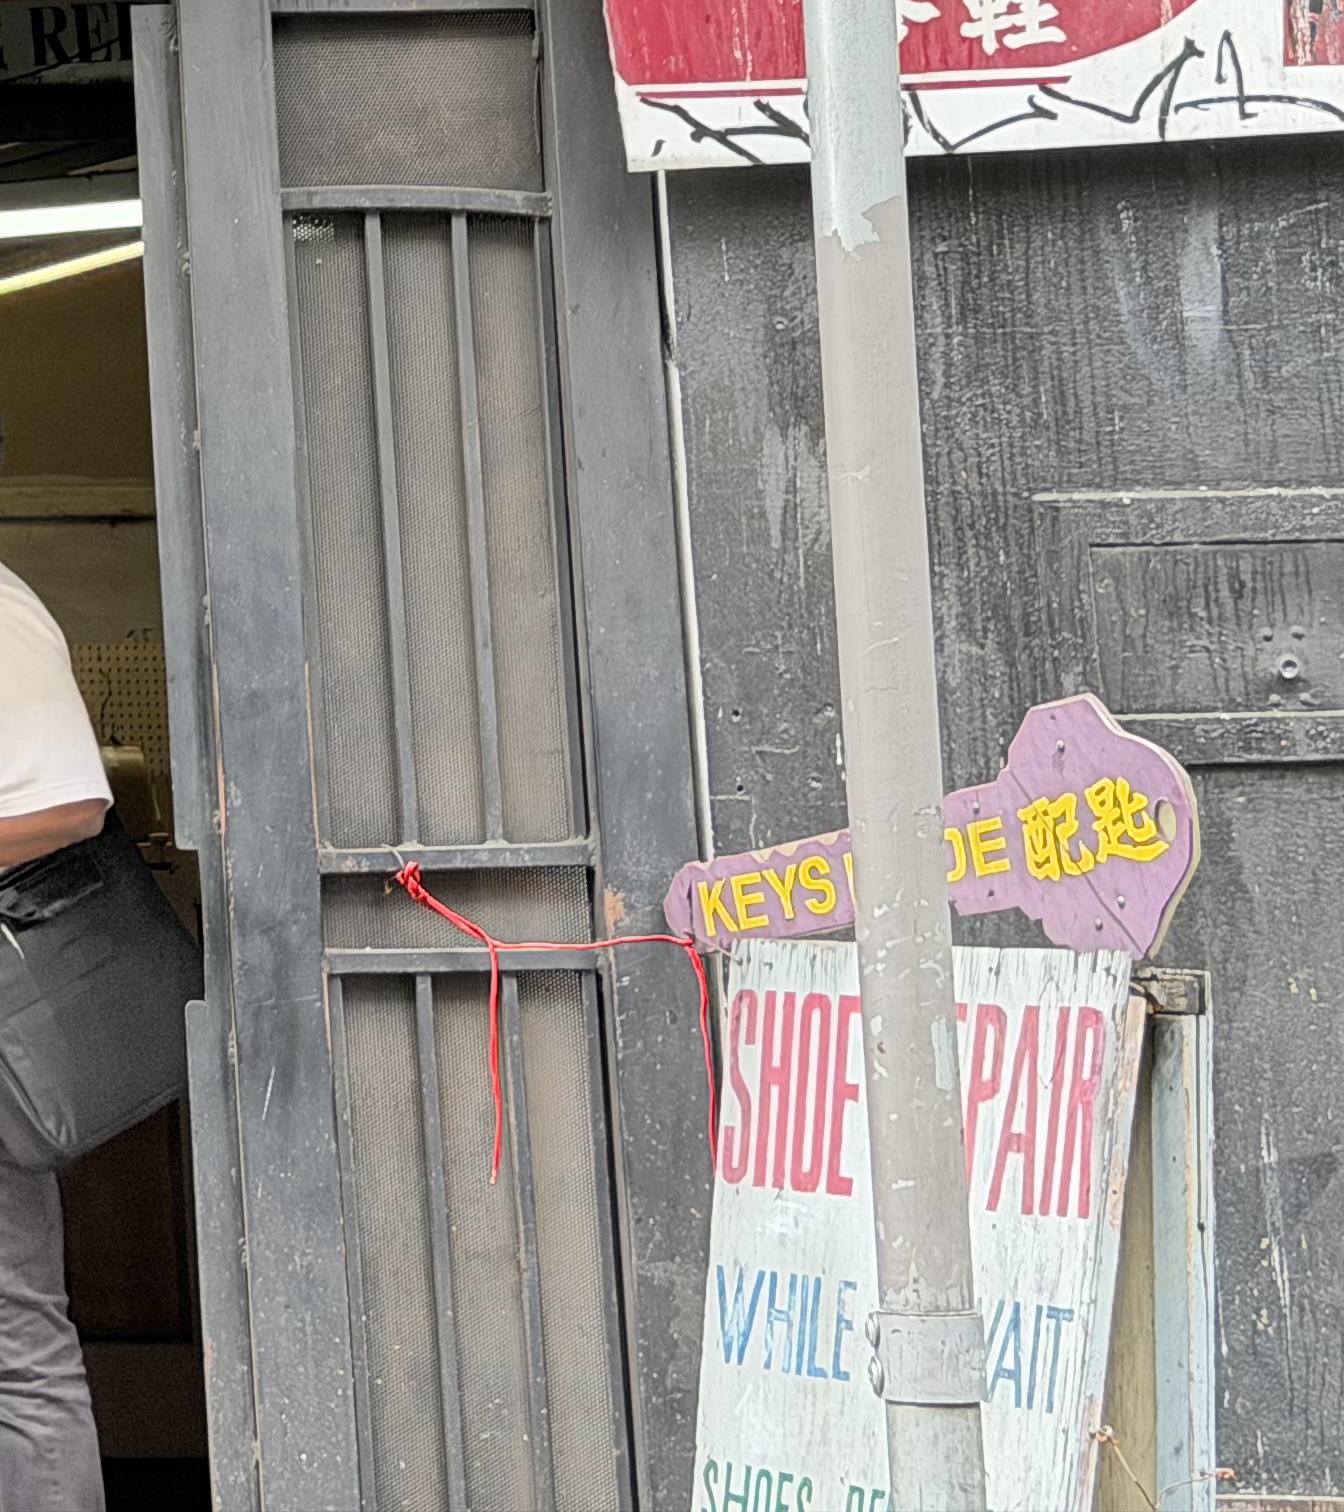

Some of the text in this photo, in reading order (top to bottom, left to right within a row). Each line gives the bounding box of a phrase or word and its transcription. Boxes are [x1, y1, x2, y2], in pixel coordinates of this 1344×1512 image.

[1016, 776, 1170, 881] 配匙
[699, 854, 838, 938] KEYS
[722, 988, 1107, 1219] SHOE PAIR
[715, 1264, 858, 1382] WHILE
